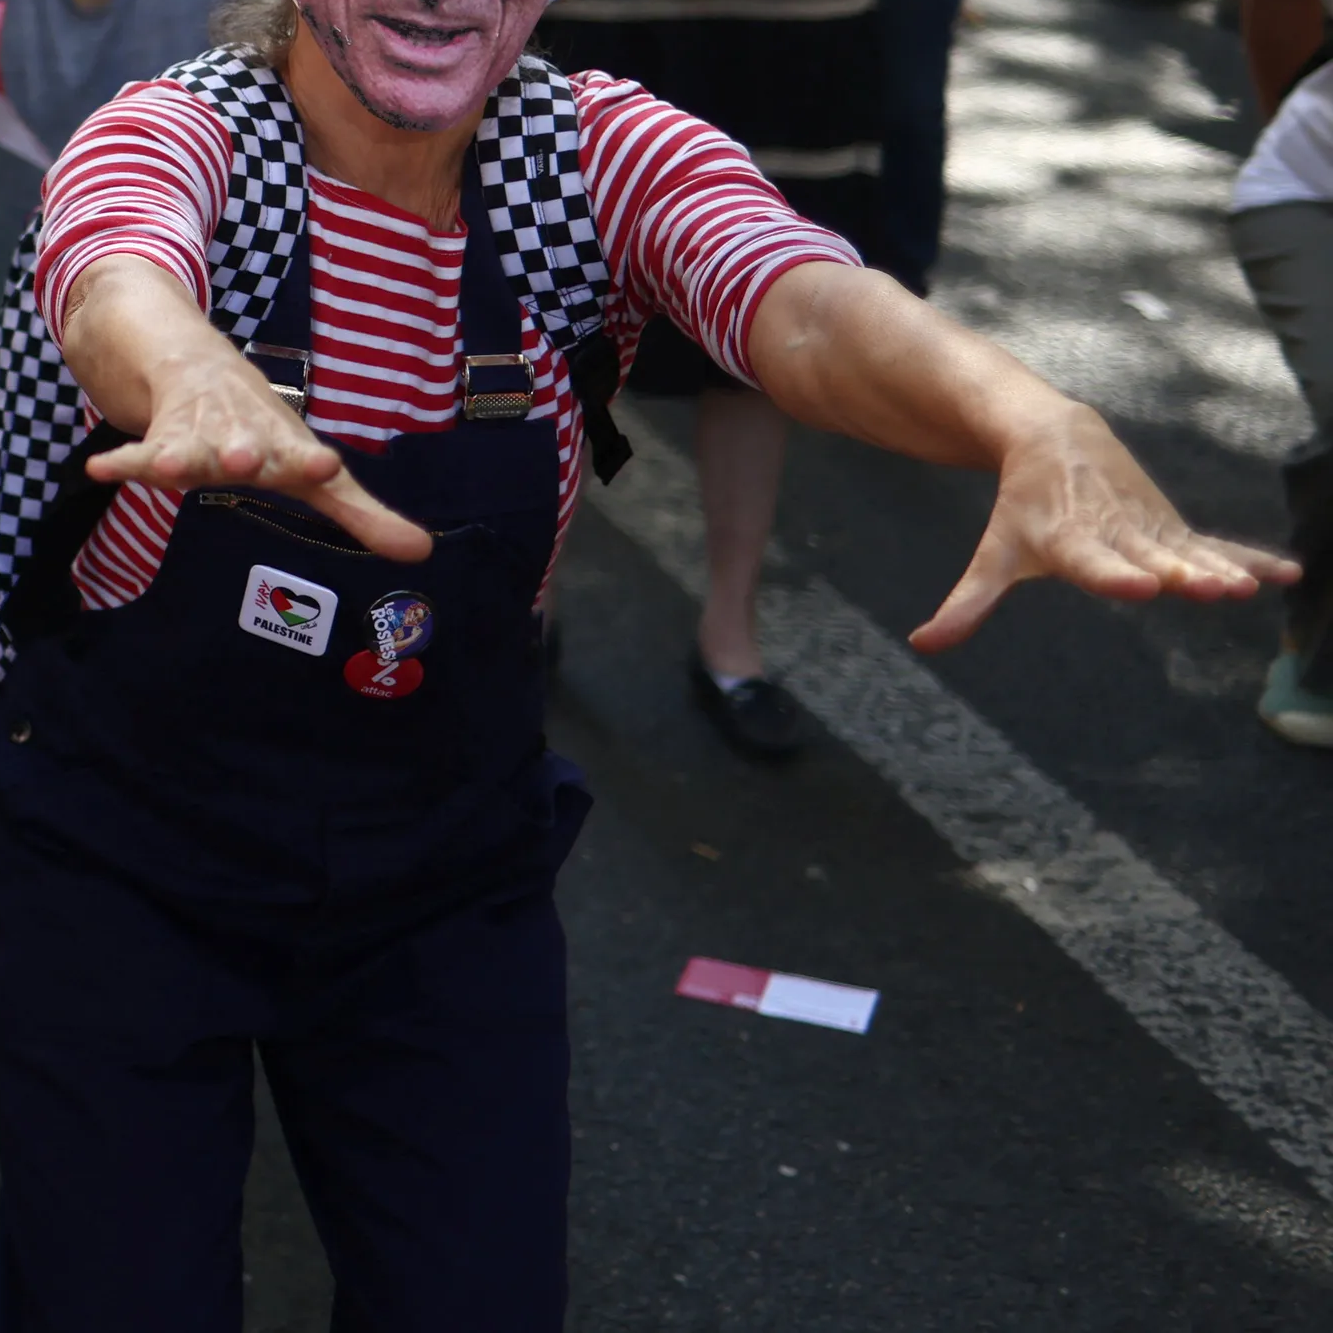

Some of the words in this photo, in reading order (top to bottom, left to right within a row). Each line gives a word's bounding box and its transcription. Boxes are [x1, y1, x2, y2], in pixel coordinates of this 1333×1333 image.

[383, 601, 397, 622] Les
[253, 615, 314, 647] PALESTINE
[370, 607, 397, 661] ROSIES
[360, 685, 393, 698] attac
